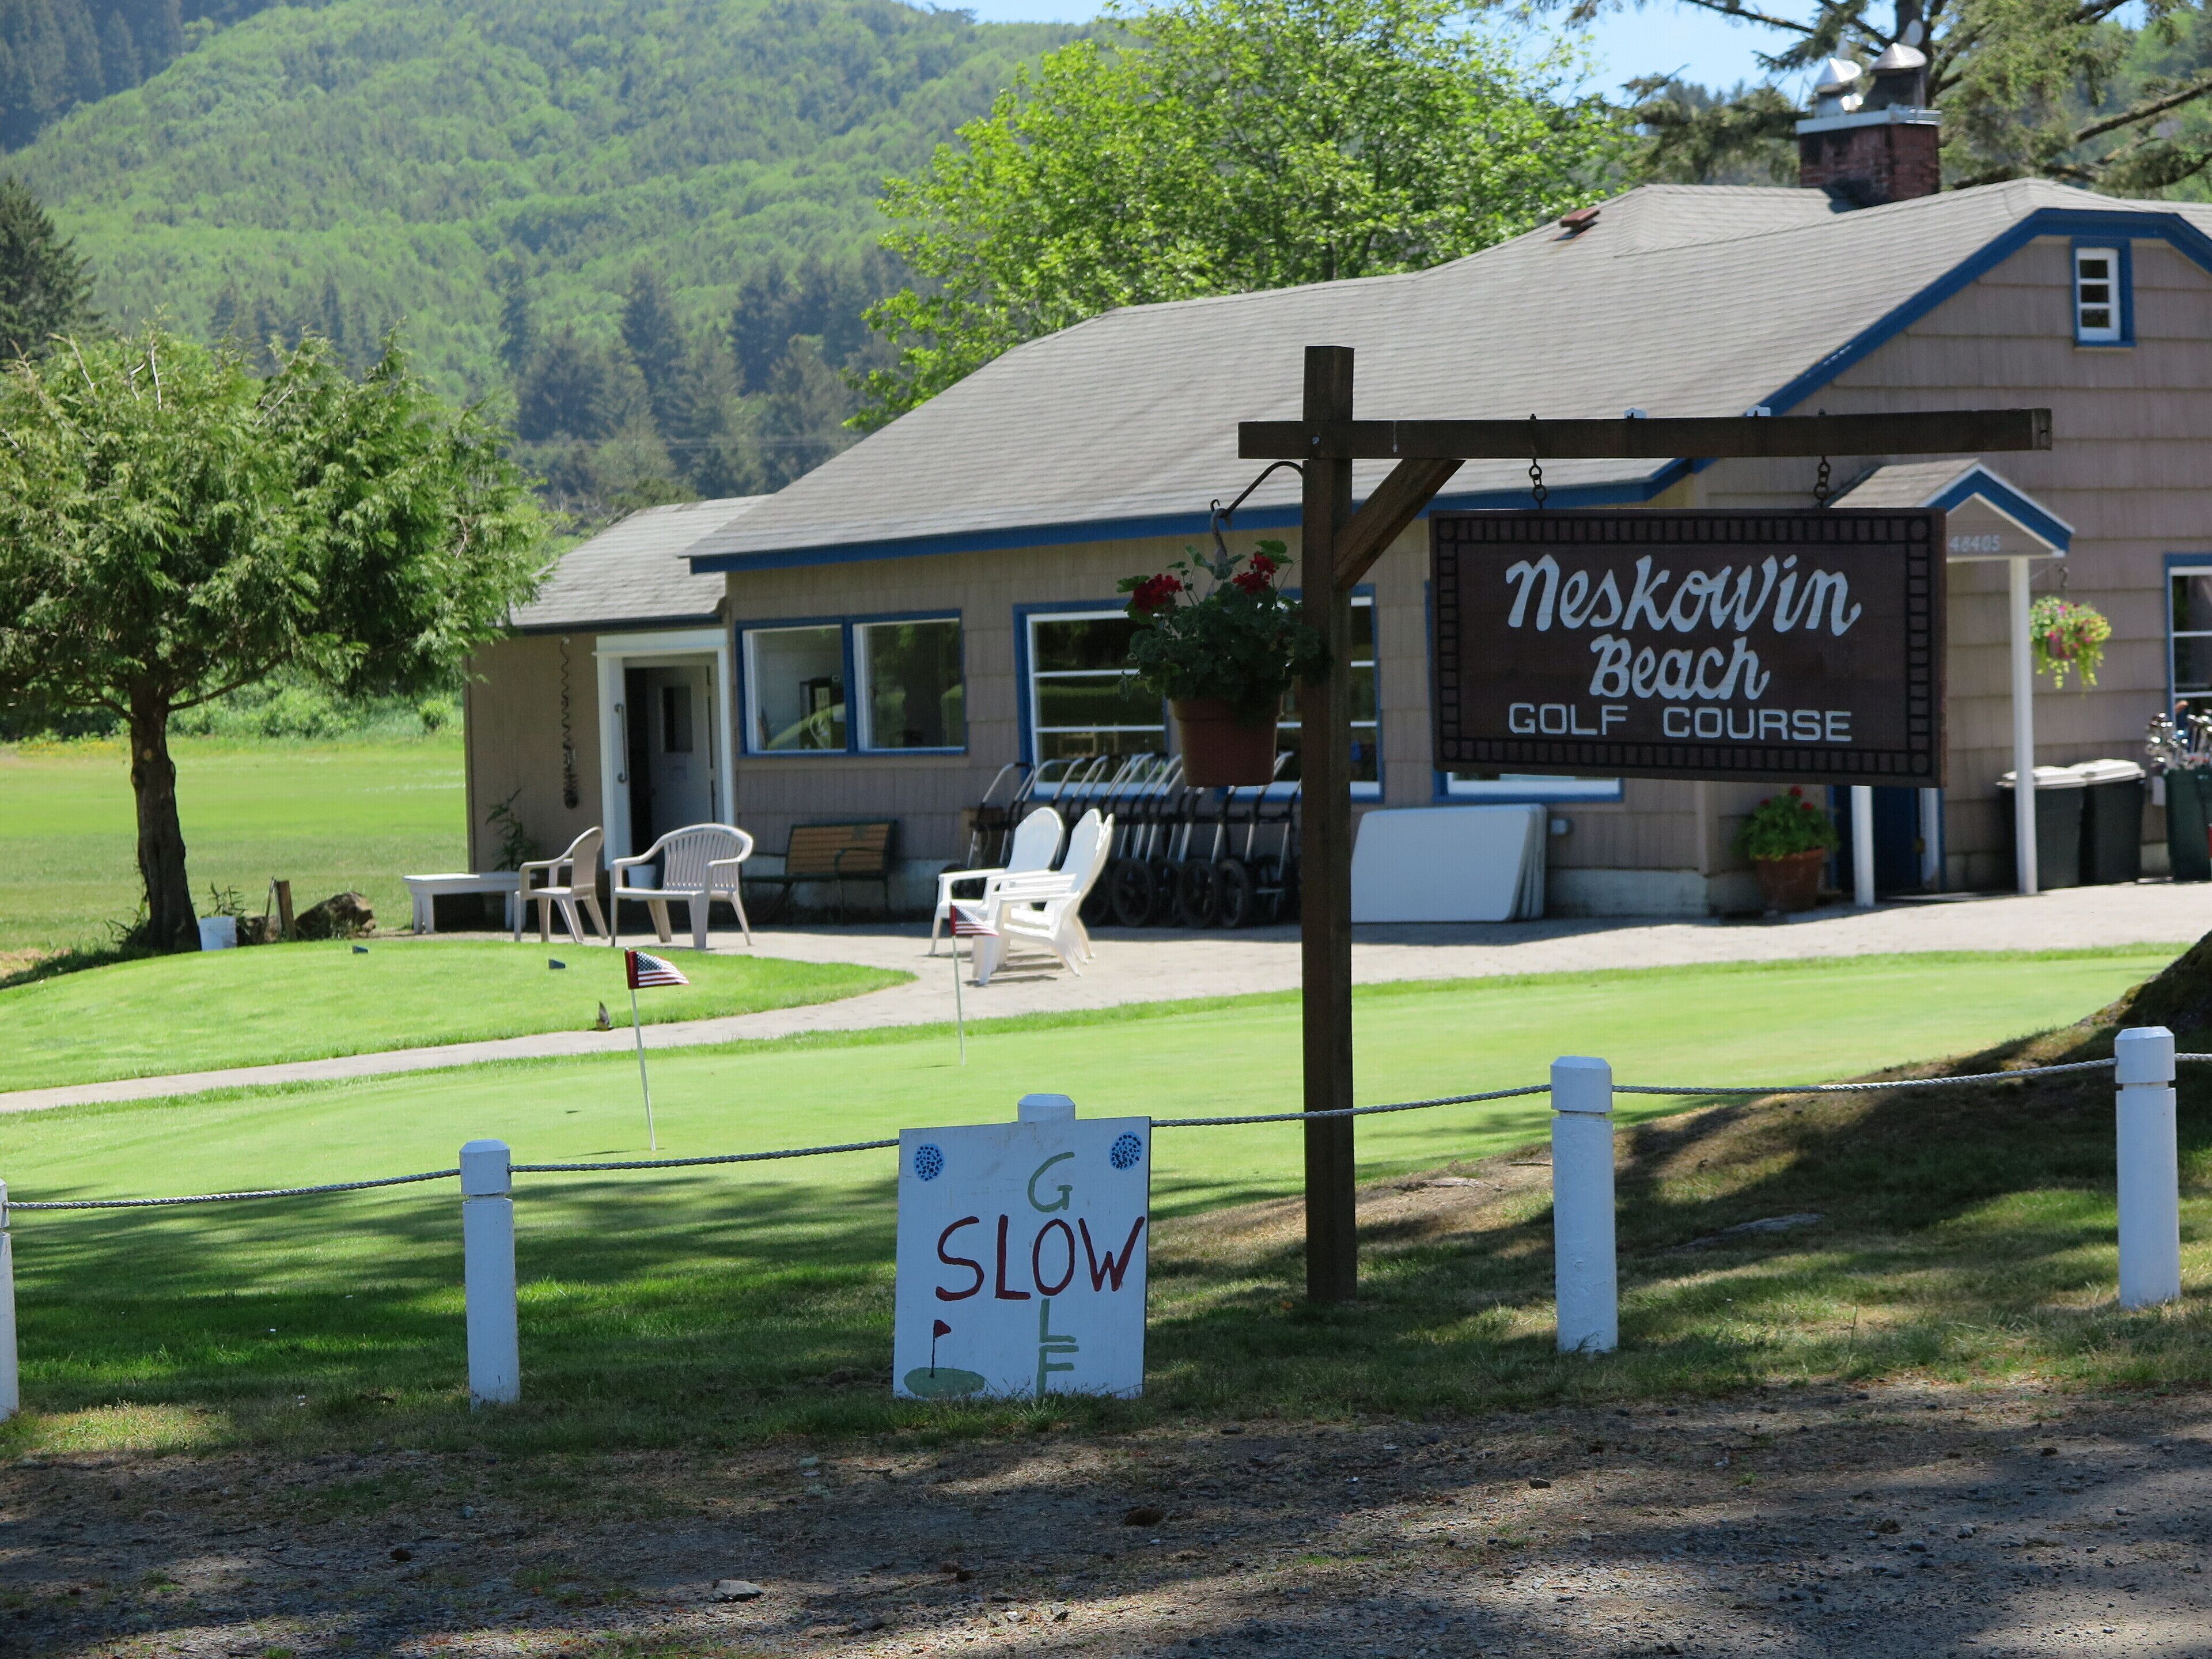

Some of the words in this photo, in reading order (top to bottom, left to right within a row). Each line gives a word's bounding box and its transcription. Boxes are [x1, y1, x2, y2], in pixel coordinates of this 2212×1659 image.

[1505, 554, 1862, 637] Neskowin
[1589, 633, 1771, 700] Beach
[1508, 702, 1628, 736] GOLF
[1662, 706, 1852, 741] COURSE
[935, 1214, 1146, 1302] SLOW
